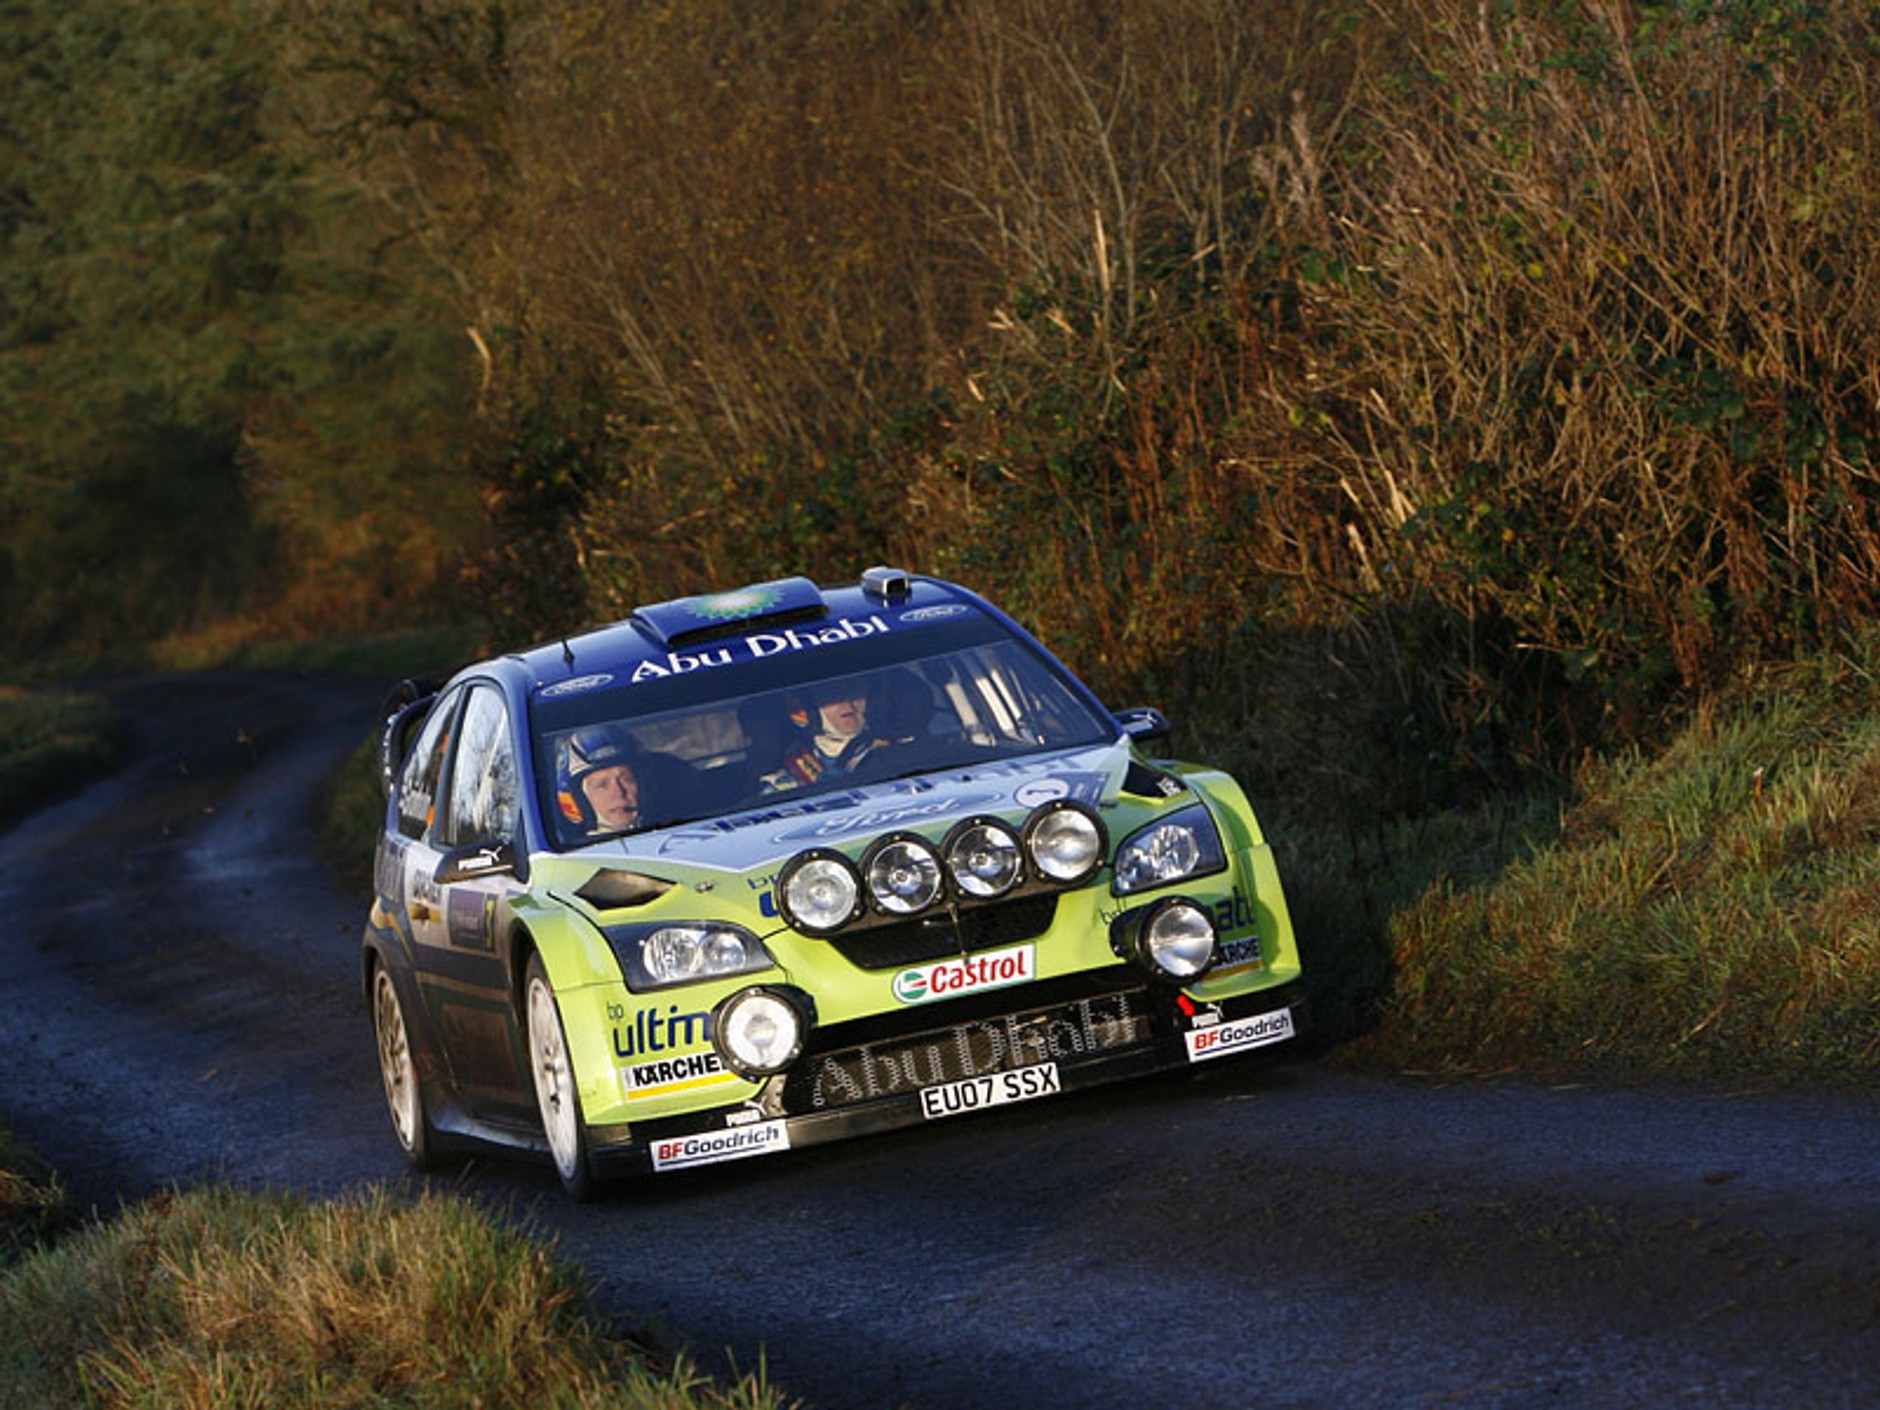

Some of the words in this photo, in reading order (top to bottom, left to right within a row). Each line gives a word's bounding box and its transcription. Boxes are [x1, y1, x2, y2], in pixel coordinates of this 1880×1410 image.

[631, 649, 733, 684] Abu
[745, 615, 891, 658] Dhabi
[930, 951, 1026, 994] Castrol
[613, 1004, 711, 1058] ultim
[1194, 1015, 1289, 1050] BFGoodrich
[632, 1052, 728, 1087] KÄRCHE
[923, 1079, 995, 1115] EU07
[1003, 1065, 1060, 1099] SSX
[658, 1126, 779, 1160] BFGoodrich
